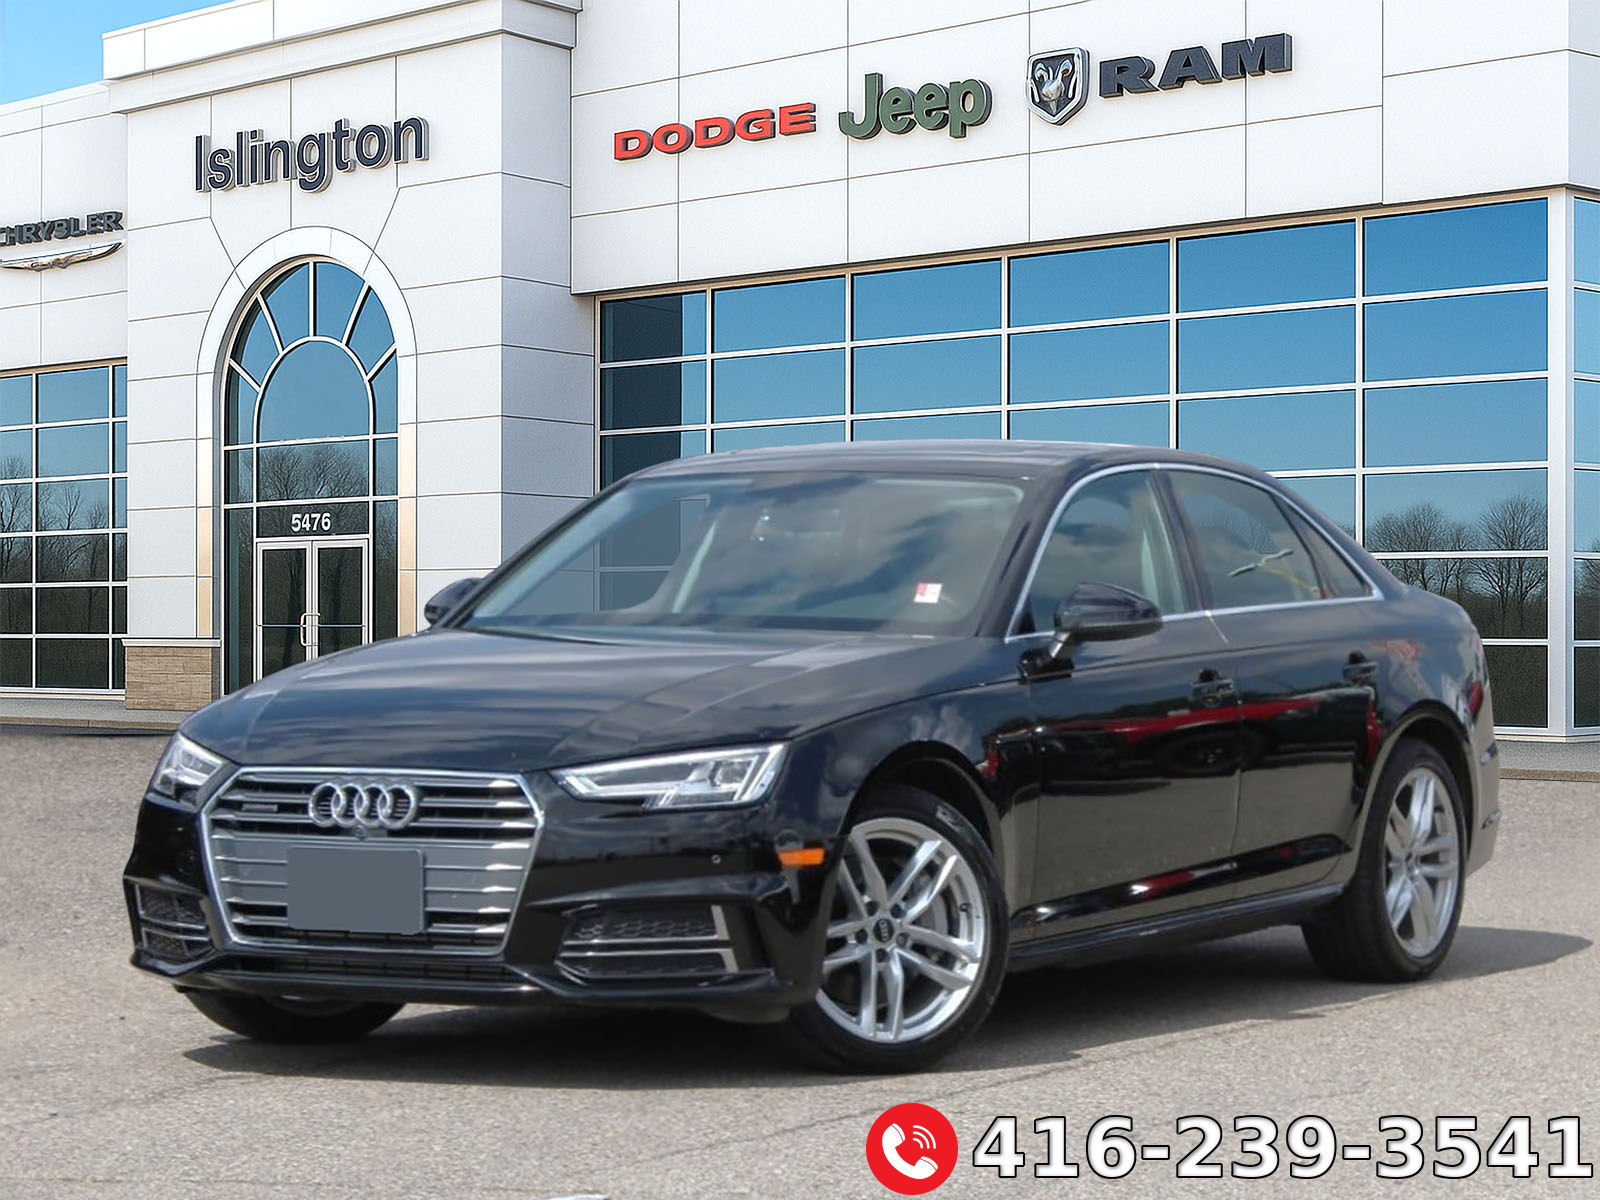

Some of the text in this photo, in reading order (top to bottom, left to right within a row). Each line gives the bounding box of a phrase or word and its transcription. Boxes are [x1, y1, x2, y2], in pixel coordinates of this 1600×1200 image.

[614, 33, 1293, 161] DODGE Jeep RAM
[195, 116, 430, 192] Islington
[291, 512, 331, 532] 5476
